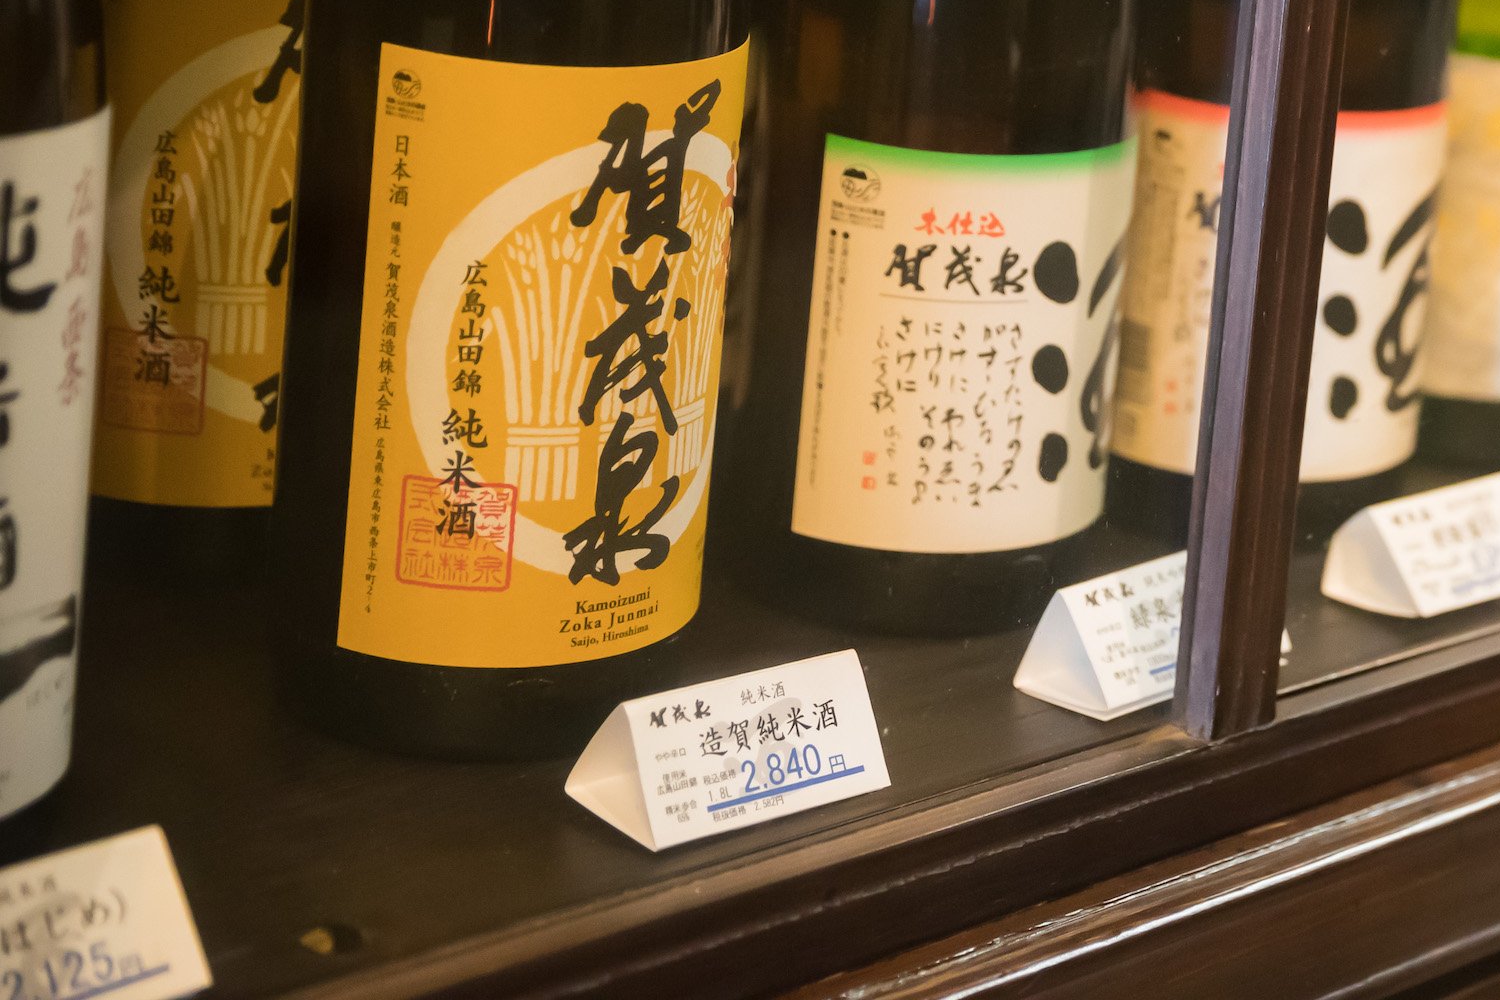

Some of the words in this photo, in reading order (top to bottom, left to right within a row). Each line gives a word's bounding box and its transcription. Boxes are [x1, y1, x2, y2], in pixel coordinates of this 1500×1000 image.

[388, 134, 412, 207] 日本酒
[133, 264, 181, 388] 純米酒
[373, 262, 402, 431] 賀茂泉酒造株式会社
[452, 259, 489, 396] 広島山田錦
[563, 78, 722, 587] 賀茂泉
[434, 408, 489, 541] 純米酒
[559, 616, 602, 634] Zoka
[607, 600, 660, 630] Junmai
[570, 636, 600, 649] Saijo,
[602, 624, 649, 643] Hiroshima
[575, 586, 652, 615] Kamoizumi
[698, 698, 839, 758] 造賀純米酒
[740, 680, 786, 706] 純米酒
